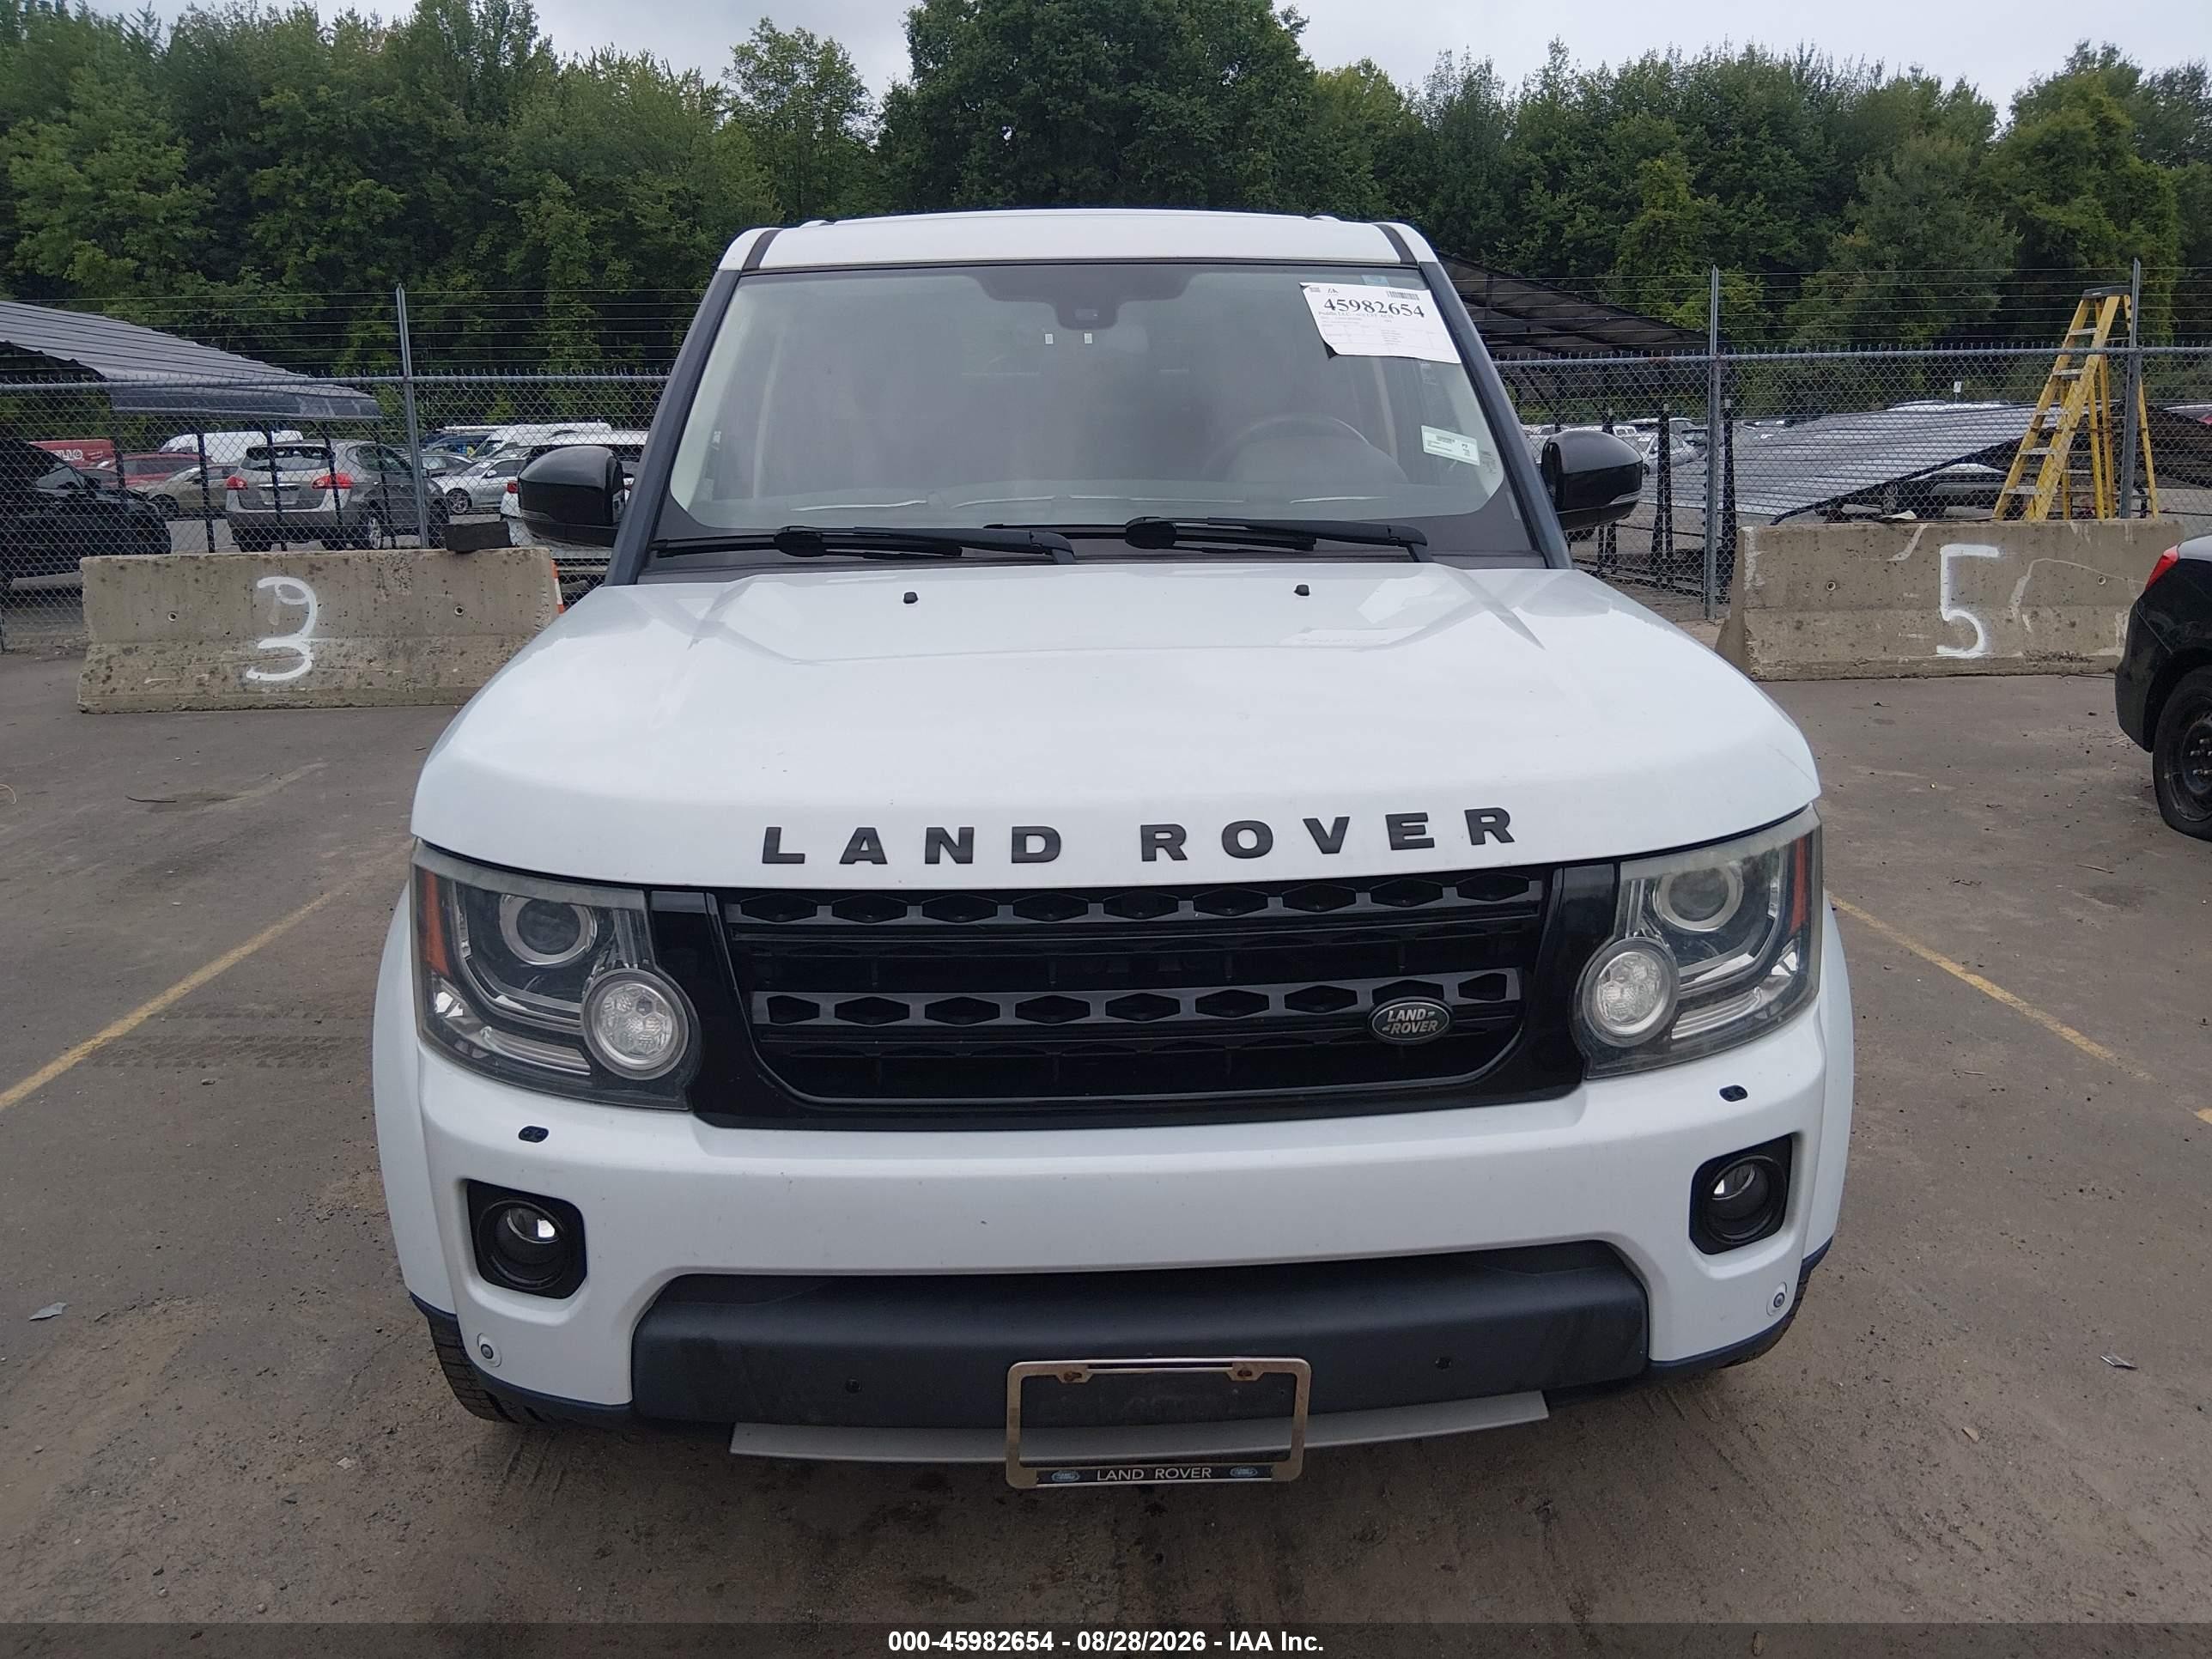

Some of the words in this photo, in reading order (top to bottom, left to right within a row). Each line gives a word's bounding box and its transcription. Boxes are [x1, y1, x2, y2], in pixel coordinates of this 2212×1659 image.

[1323, 298, 1425, 318] 45982654
[1936, 544, 2001, 659] 5
[246, 576, 319, 682] 3
[762, 826, 1062, 865] LAND
[1139, 807, 1516, 862] ROVER
[1387, 1008, 1426, 1023] LAND
[1389, 1019, 1438, 1034] ROVER
[1097, 1468, 1145, 1481] LAND
[1155, 1467, 1212, 1480] ROVER
